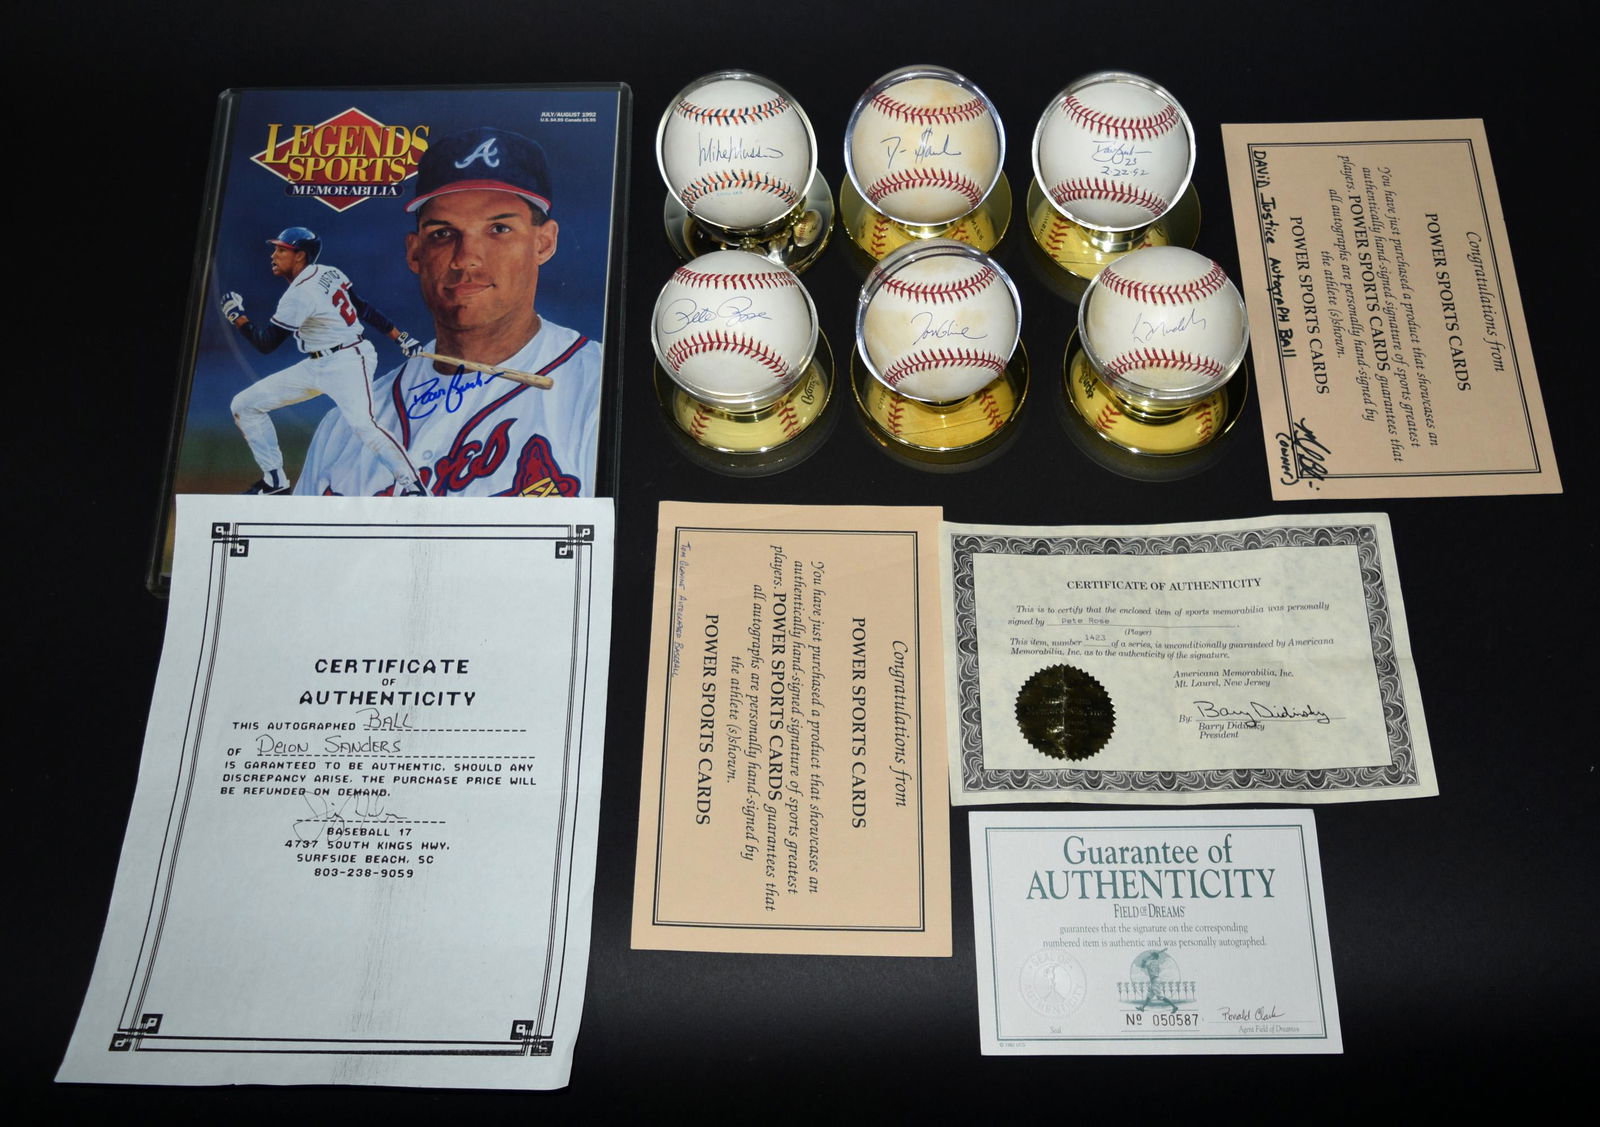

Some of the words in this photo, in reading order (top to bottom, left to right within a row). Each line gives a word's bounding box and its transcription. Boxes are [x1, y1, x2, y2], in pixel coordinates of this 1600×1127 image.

[262, 124, 430, 166] LEGENDS
[288, 156, 407, 182] SPORTS
[292, 184, 397, 196] MEMORABILIA
[1290, 217, 1310, 270] POWER
[1298, 274, 1320, 334] SPORTS
[1425, 213, 1447, 267] POWER
[1436, 271, 1460, 331] SPORTS
[1449, 335, 1471, 391] CARDS
[1466, 231, 1497, 336] Congratulations
[1484, 340, 1506, 372] from
[1309, 338, 1330, 394] CARDS
[769, 545, 786, 589] players.
[813, 561, 825, 585] You
[1067, 580, 1147, 590] CERTIFICATE
[1150, 582, 1166, 591] OF
[1170, 578, 1260, 591] AUTHENTICITY
[812, 588, 826, 616] have
[1016, 605, 1034, 613] This
[1058, 605, 1083, 615] certify
[1120, 606, 1151, 615] enclosed
[1155, 607, 1171, 616] item
[1174, 608, 1183, 617] of
[1186, 608, 1209, 617] sports
[1213, 605, 1264, 614] memorabilia
[1287, 601, 1330, 612] personally
[772, 593, 787, 655] POWER
[809, 618, 825, 642] just
[1088, 616, 1110, 624] Rose
[703, 615, 719, 677] POWER
[852, 618, 866, 680] POWER
[315, 659, 469, 674] CERTIFICATE
[808, 645, 825, 707] purchased
[1173, 669, 1219, 678] Americana
[1222, 668, 1277, 678] Memorabilia,
[1280, 668, 1294, 677] Inc.
[381, 678, 396, 686] OF
[769, 660, 785, 730] SPORTS
[300, 690, 475, 706] AUTHENTICITY
[889, 640, 910, 764] Congratulations
[699, 682, 716, 752] SPORTS
[811, 709, 821, 717] a
[852, 686, 866, 756] SPORTS
[232, 722, 259, 730] THIS
[267, 722, 356, 731] AUTOGRAPHED
[1198, 722, 1225, 733] Barry
[1200, 730, 1238, 739] President
[227, 748, 242, 756] OF
[807, 720, 824, 769] product
[222, 773, 306, 783] DISCREPANCY
[362, 775, 385, 784] THE
[393, 775, 458, 785] PURCHASE
[466, 776, 501, 785] PRICE
[510, 777, 536, 786] WILL
[224, 761, 236, 769] IS
[244, 761, 316, 770] GARANTEED
[324, 761, 341, 770] TO
[348, 762, 363, 770] BE
[454, 763, 502, 772] SHOULD
[510, 763, 533, 772] ANY
[768, 735, 784, 800] CARDS
[220, 786, 235, 795] BE
[243, 786, 306, 796] REFUNDED
[313, 788, 330, 796] ON
[338, 788, 390, 798] DEMAND.
[696, 758, 713, 825] CARDS
[810, 773, 824, 801] that
[852, 762, 866, 828] CARDS
[890, 768, 912, 807] from
[284, 839, 318, 849] 4737
[327, 839, 370, 849] SOUTH
[377, 841, 412, 850] KINGS
[421, 842, 450, 850] HWY.
[327, 826, 390, 837] BASEBALL
[399, 828, 412, 836] 17
[763, 804, 777, 878] guarantees
[809, 804, 824, 872] showcases
[297, 853, 356, 863] SURFSIDE
[418, 855, 434, 864] SC
[1063, 836, 1198, 865] Guarantee
[1208, 833, 1232, 864] of
[314, 868, 414, 878] 803-238-9059
[808, 876, 818, 894] an
[1027, 868, 1275, 900] AUTHENTICITY
[765, 883, 780, 912] that
[1113, 903, 1139, 918] FIELD
[1042, 937, 1081, 948] numbered
[1082, 938, 1100, 948] item
[1101, 938, 1108, 947] is
[1108, 937, 1145, 947] authentic
[1146, 936, 1162, 947] and
[1178, 936, 1217, 949] personally
[1218, 936, 1267, 949] autographed.
[1059, 926, 1100, 936] guarantees
[1100, 924, 1117, 933] that
[1118, 923, 1131, 933] the
[1133, 924, 1167, 935] signature
[1180, 923, 1194, 933] the
[1194, 923, 1248, 934] corresponding
[1152, 1013, 1198, 1027] 050587
